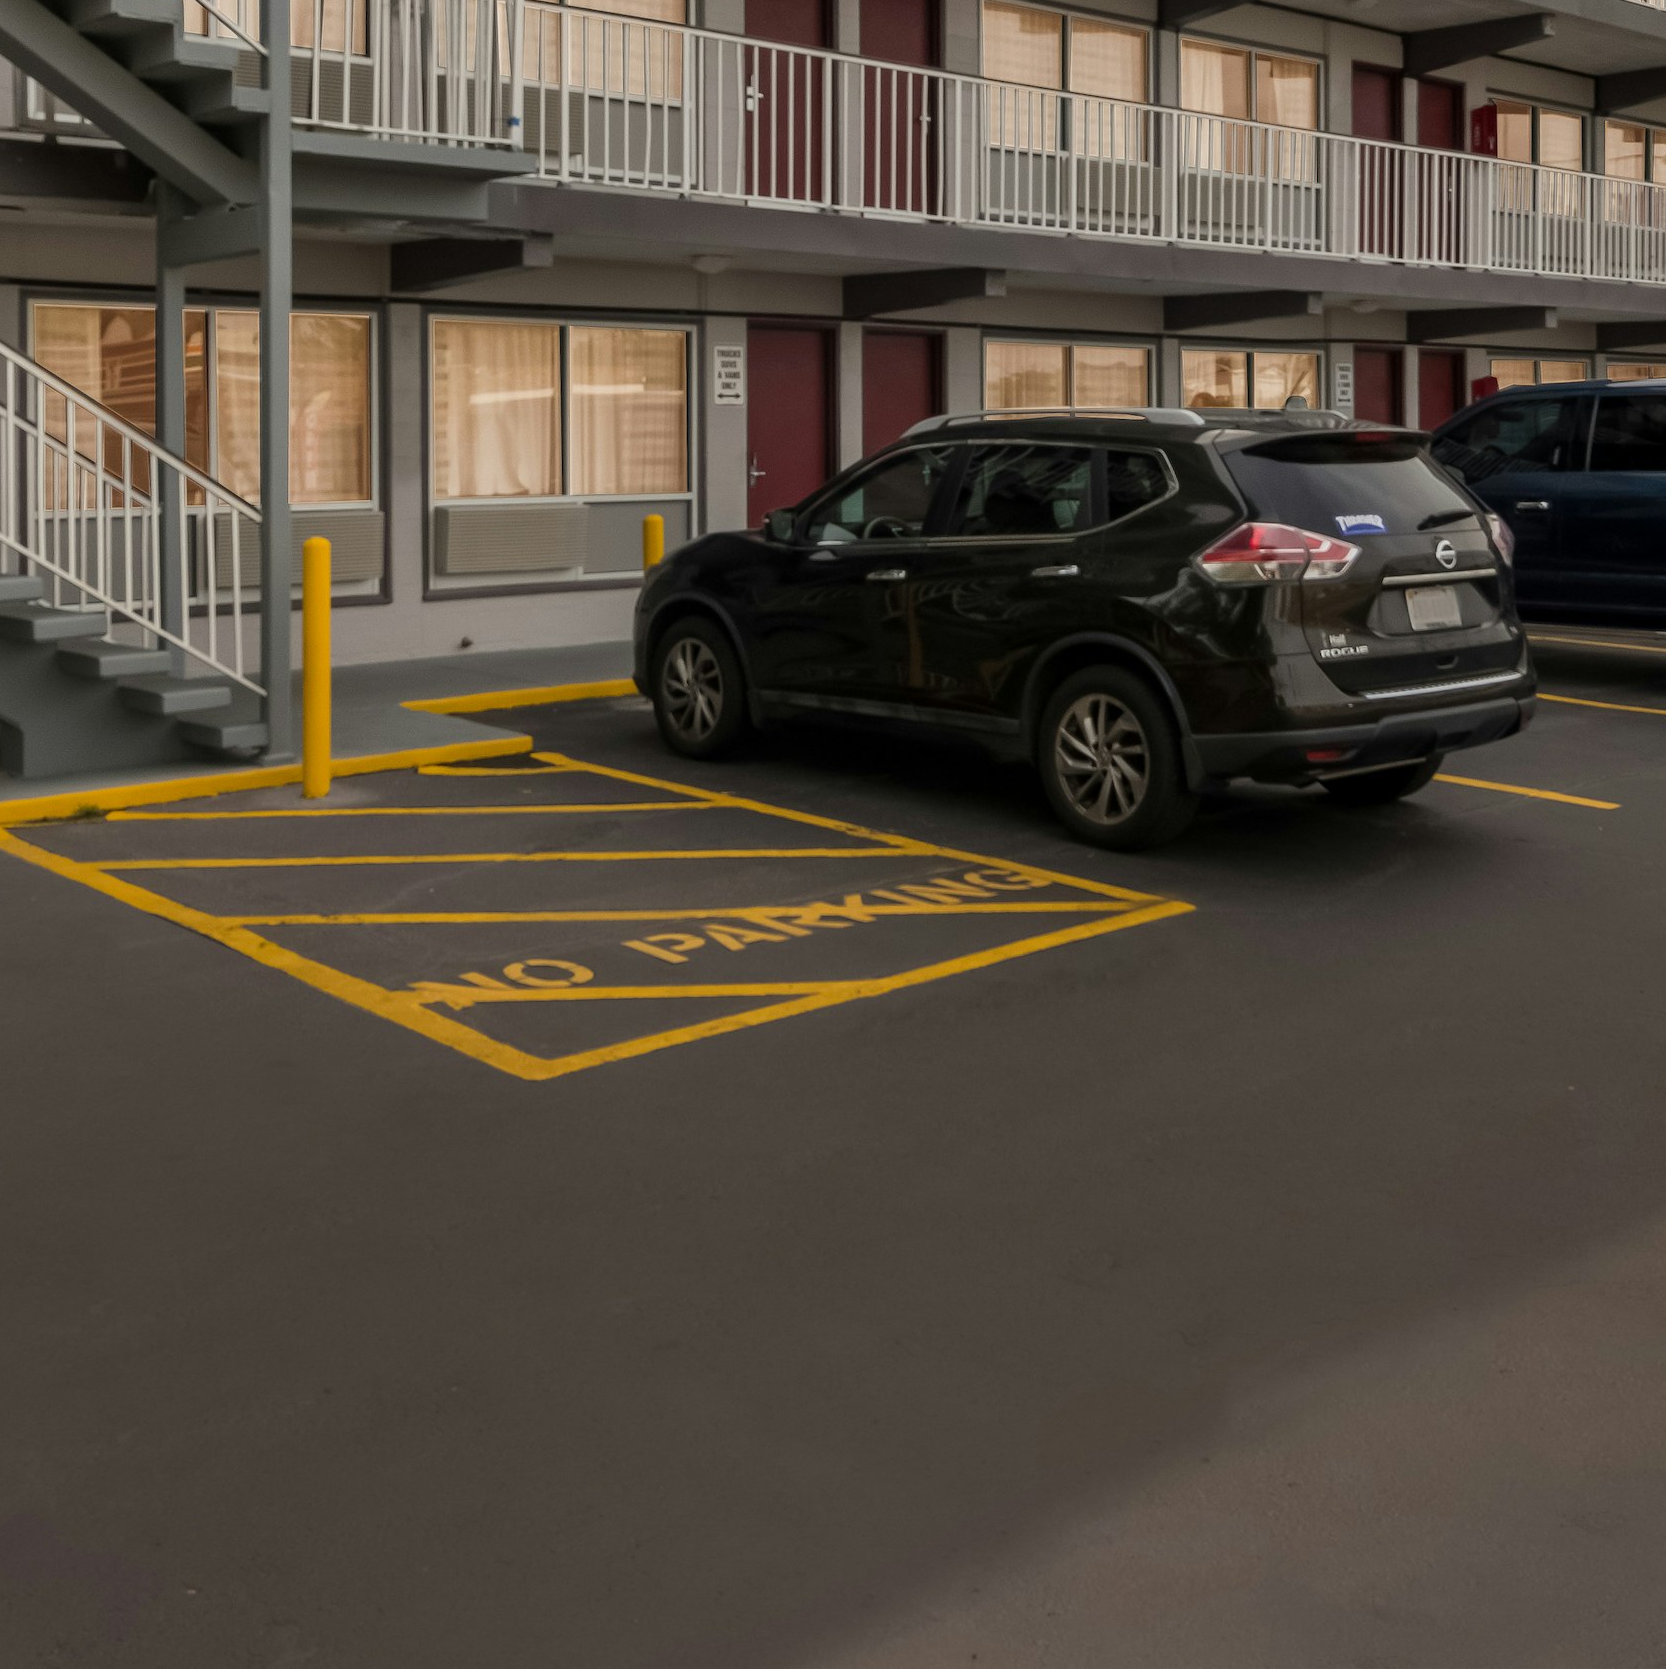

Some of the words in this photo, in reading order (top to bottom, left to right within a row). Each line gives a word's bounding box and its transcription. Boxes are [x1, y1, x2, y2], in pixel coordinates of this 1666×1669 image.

[1320, 645, 1369, 659] ROGUE
[408, 958, 595, 1011] NO
[622, 867, 1053, 964] PARKING
